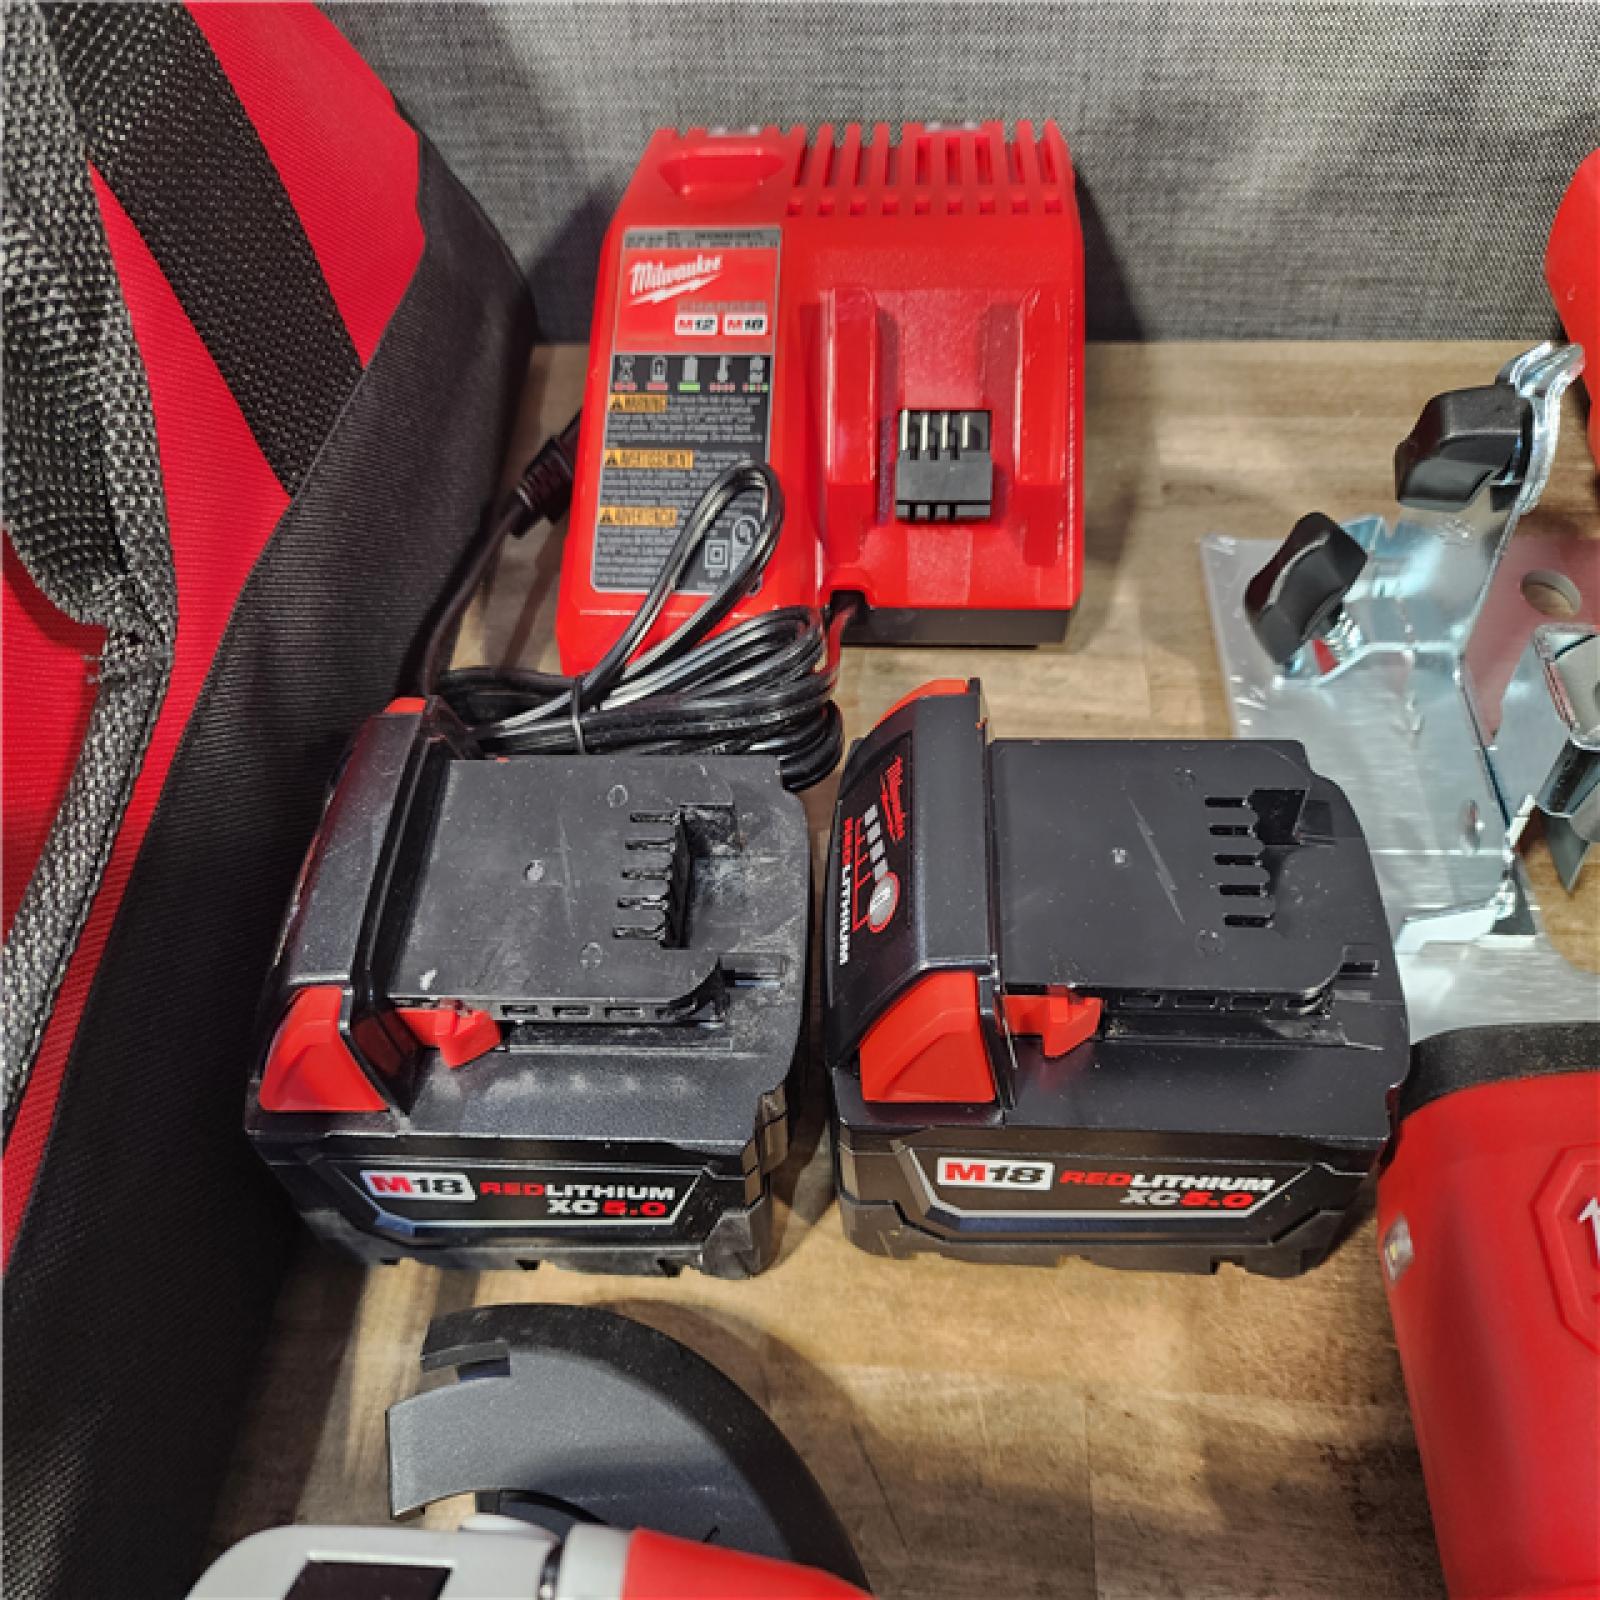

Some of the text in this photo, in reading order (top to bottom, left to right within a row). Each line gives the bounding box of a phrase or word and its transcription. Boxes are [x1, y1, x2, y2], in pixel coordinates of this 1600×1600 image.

[629, 253, 723, 297] Milwaukee
[369, 1174, 675, 1201] M18 REDLITHIUM
[944, 1162, 1275, 1191] M18 REDLITHIUM
